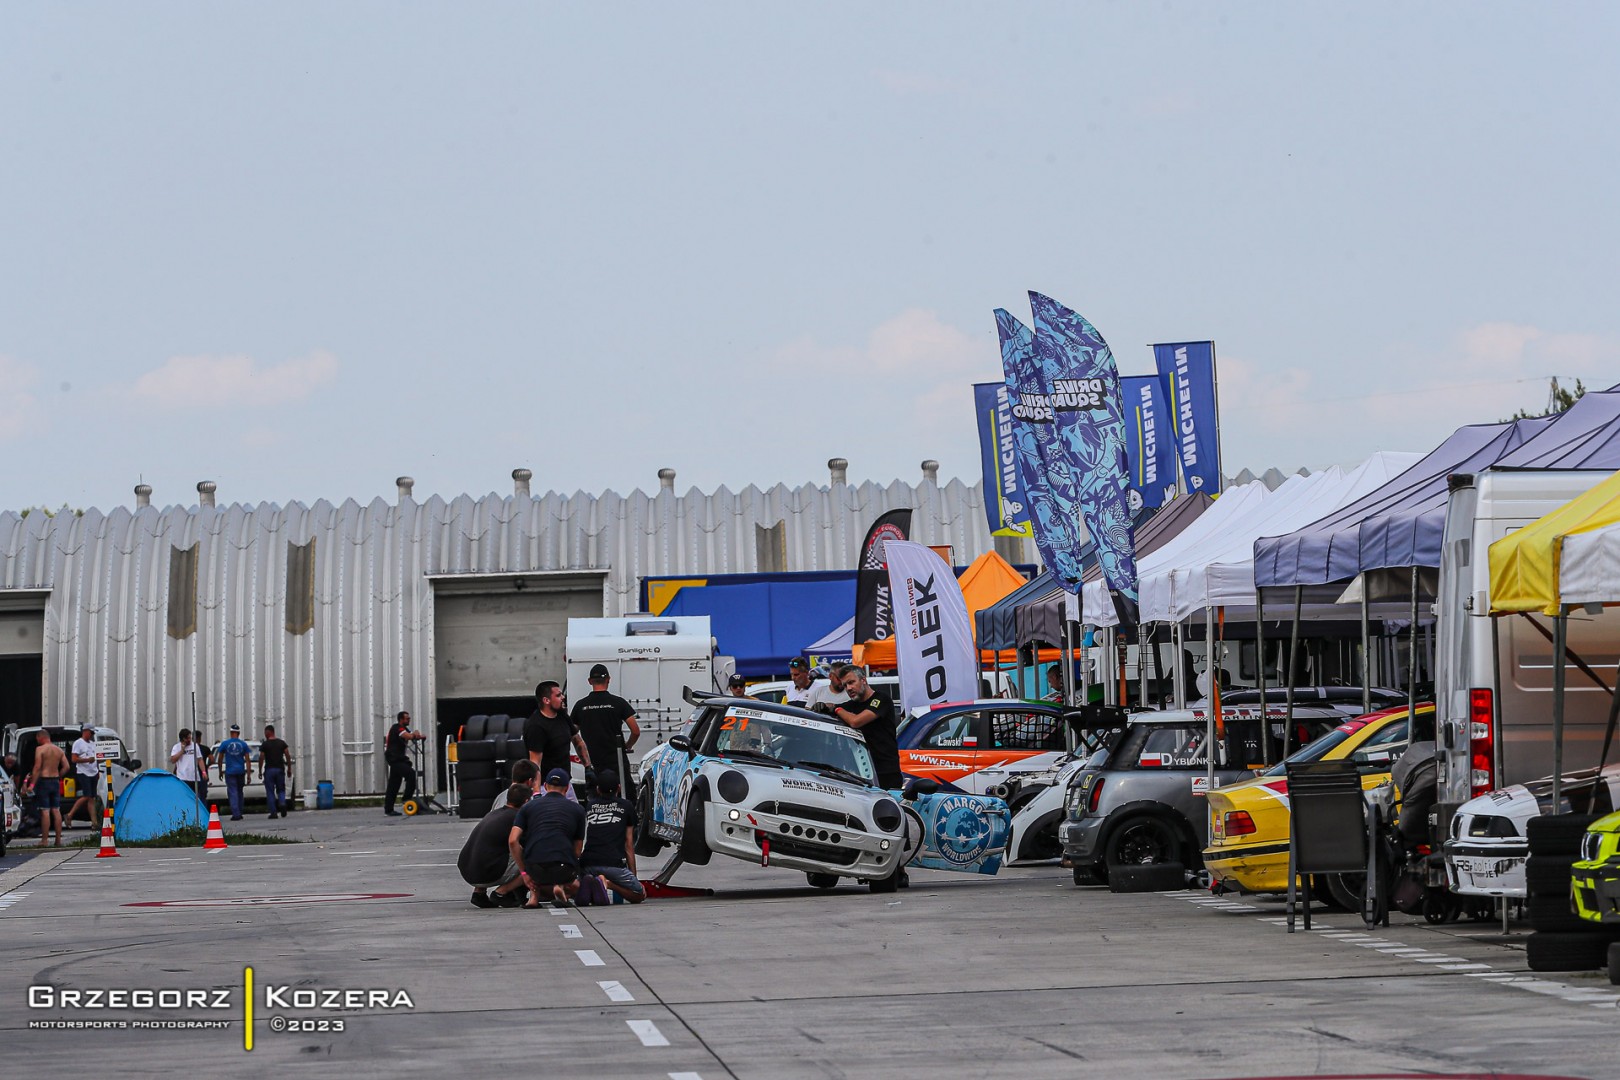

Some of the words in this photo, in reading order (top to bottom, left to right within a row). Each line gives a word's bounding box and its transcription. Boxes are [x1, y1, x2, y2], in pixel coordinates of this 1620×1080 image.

[875, 582, 889, 641] OVNIK
[720, 716, 750, 731] 21
[943, 797, 983, 815] MARGO
[942, 842, 983, 862] WORLDWIDE
